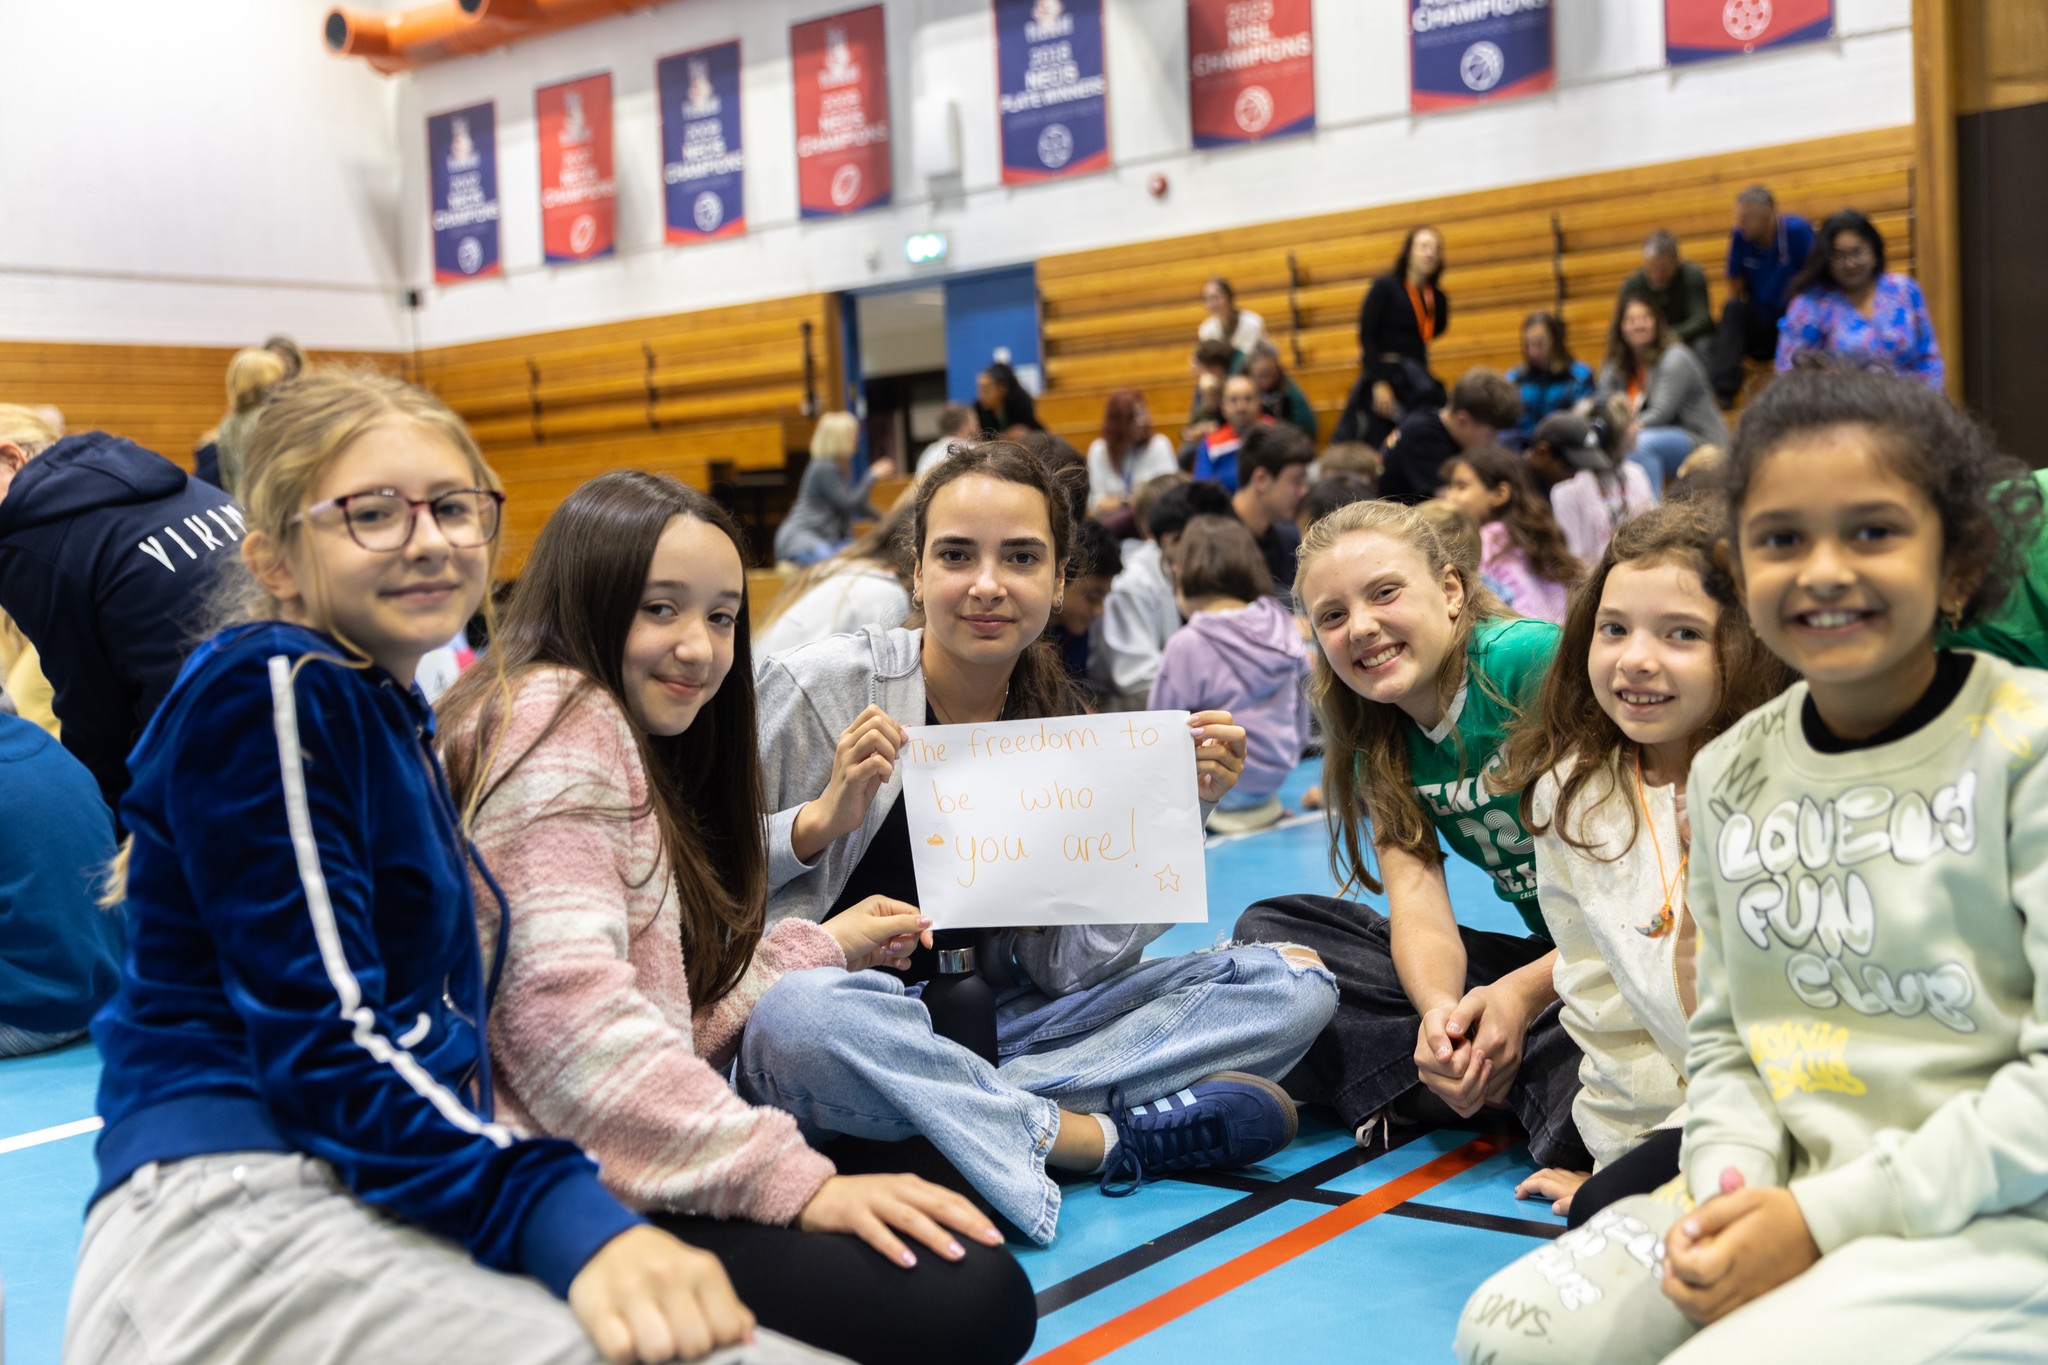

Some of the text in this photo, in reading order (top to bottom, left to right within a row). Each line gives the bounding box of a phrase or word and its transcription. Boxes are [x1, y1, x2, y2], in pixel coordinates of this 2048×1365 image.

[1193, 31, 1311, 77] CHAMPIONS
[797, 120, 890, 157] CHAMPIONS
[908, 719, 1159, 763] The freedom to
[932, 779, 1093, 814] be who
[955, 807, 1139, 888] you are!
[1737, 871, 1876, 957] FUN
